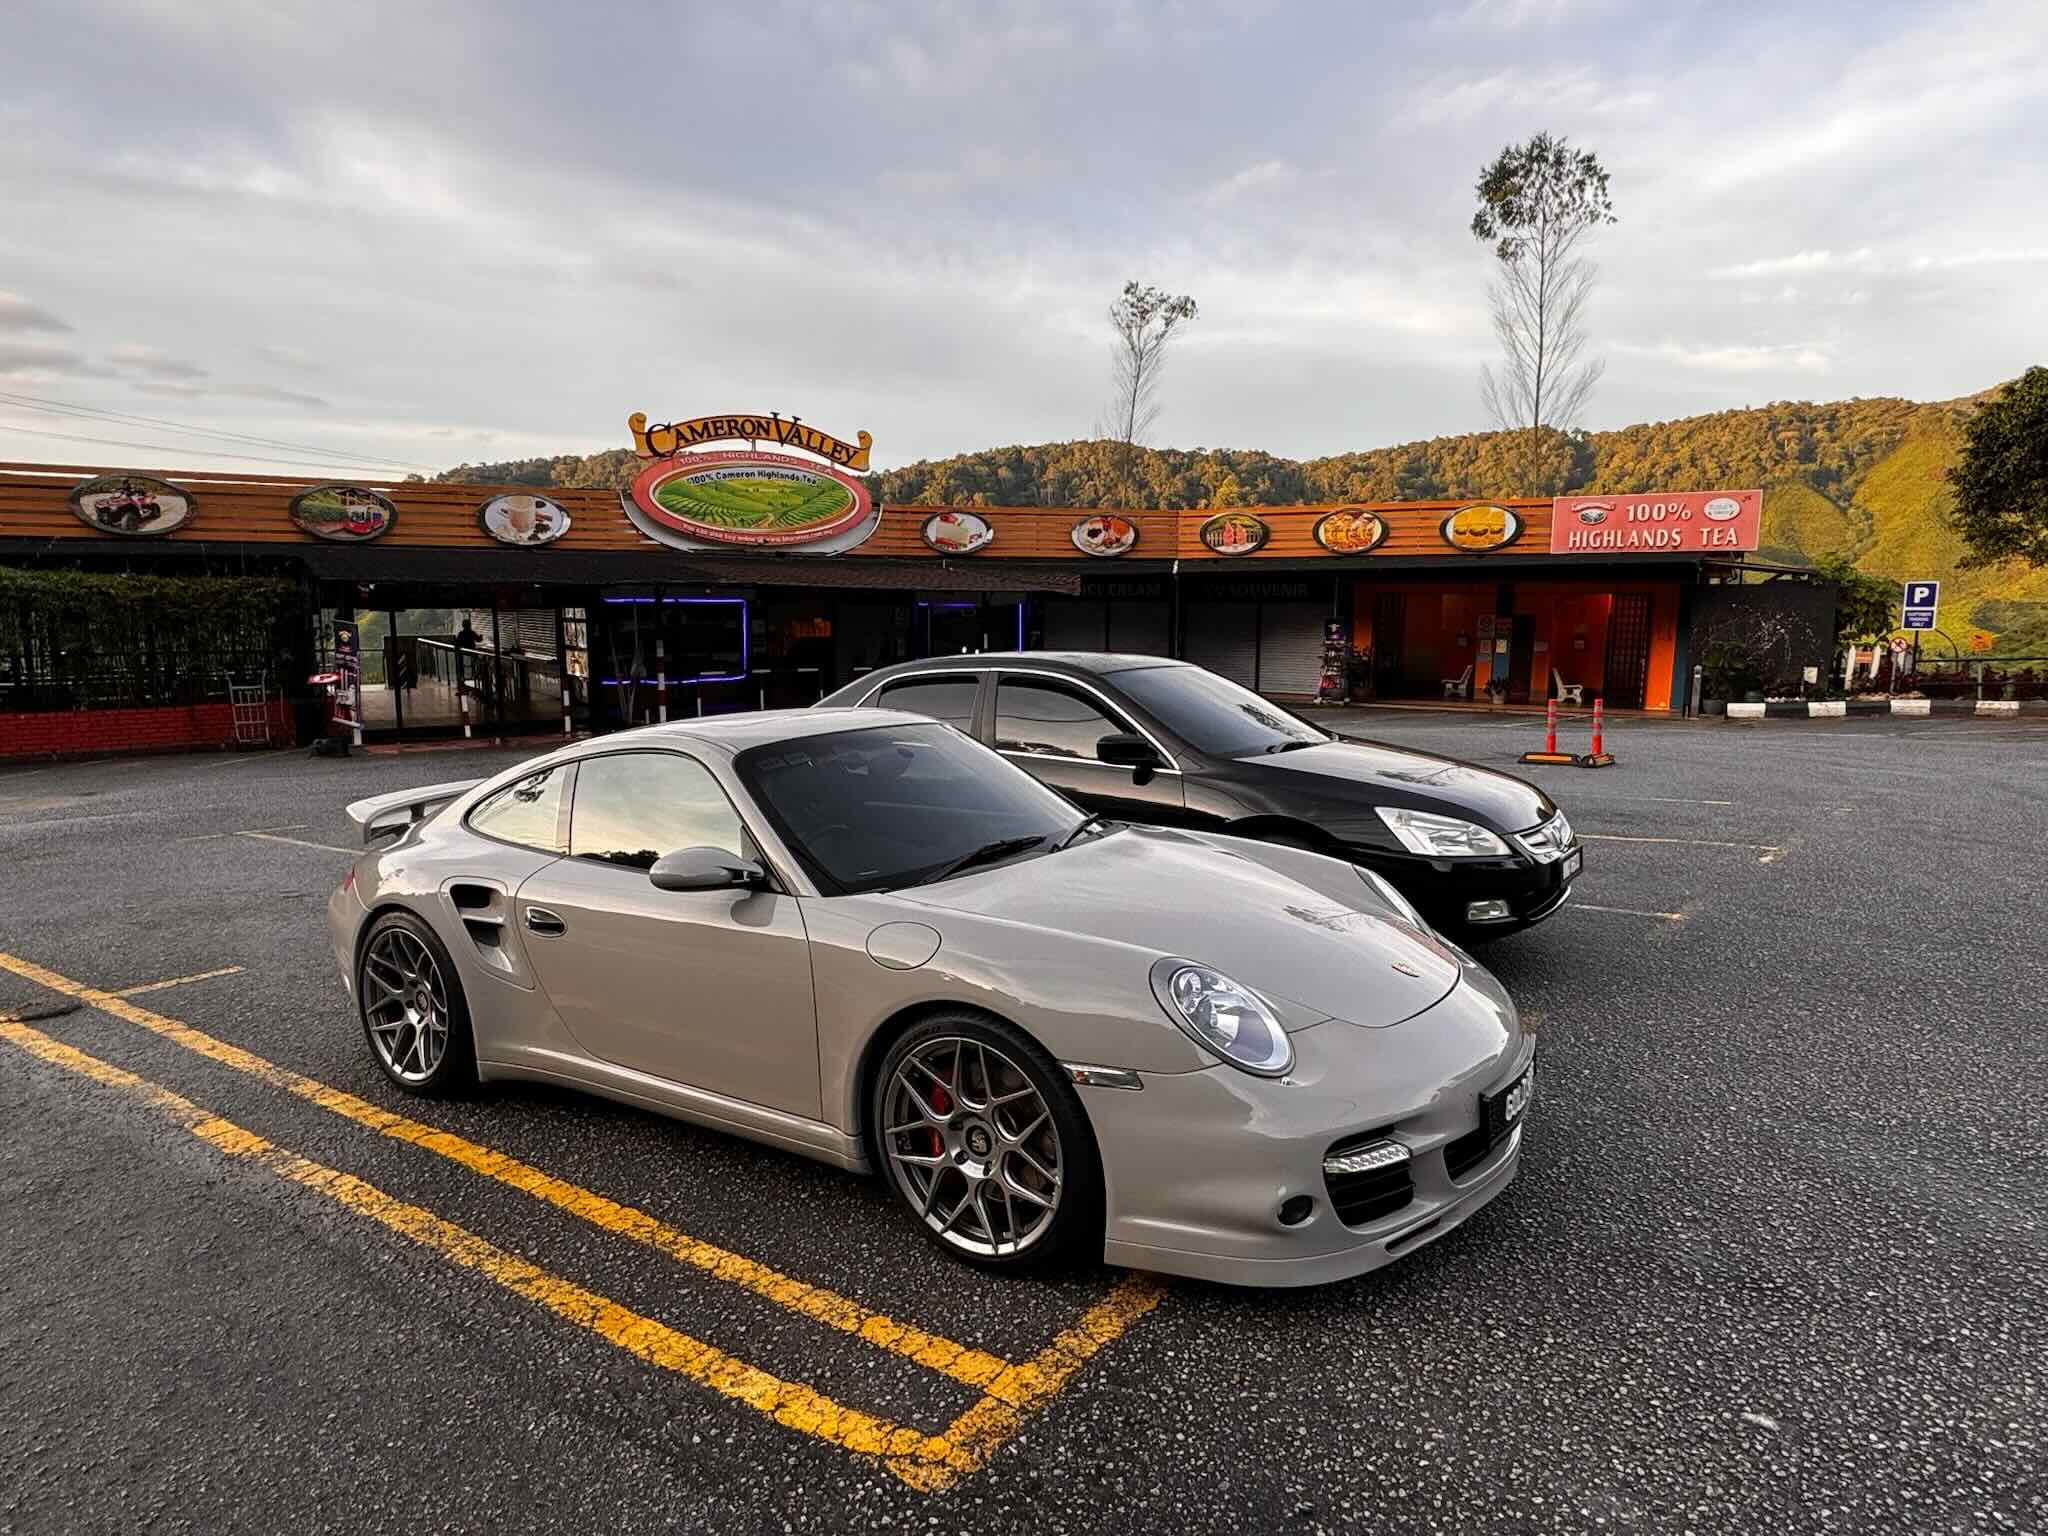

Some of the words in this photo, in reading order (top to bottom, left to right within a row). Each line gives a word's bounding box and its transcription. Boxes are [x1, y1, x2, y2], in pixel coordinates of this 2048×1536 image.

[646, 417, 770, 457] CAMERON
[770, 412, 859, 464] VALLEY
[722, 451, 798, 465] HIGHLANDS
[716, 471, 756, 480] Cameron
[757, 469, 800, 482] Highlands
[802, 474, 817, 485] Tea
[1625, 503, 1692, 522] 100%
[1568, 528, 1682, 549] HIGHLANDS
[1699, 527, 1738, 546] TEA
[1914, 587, 1929, 604] P
